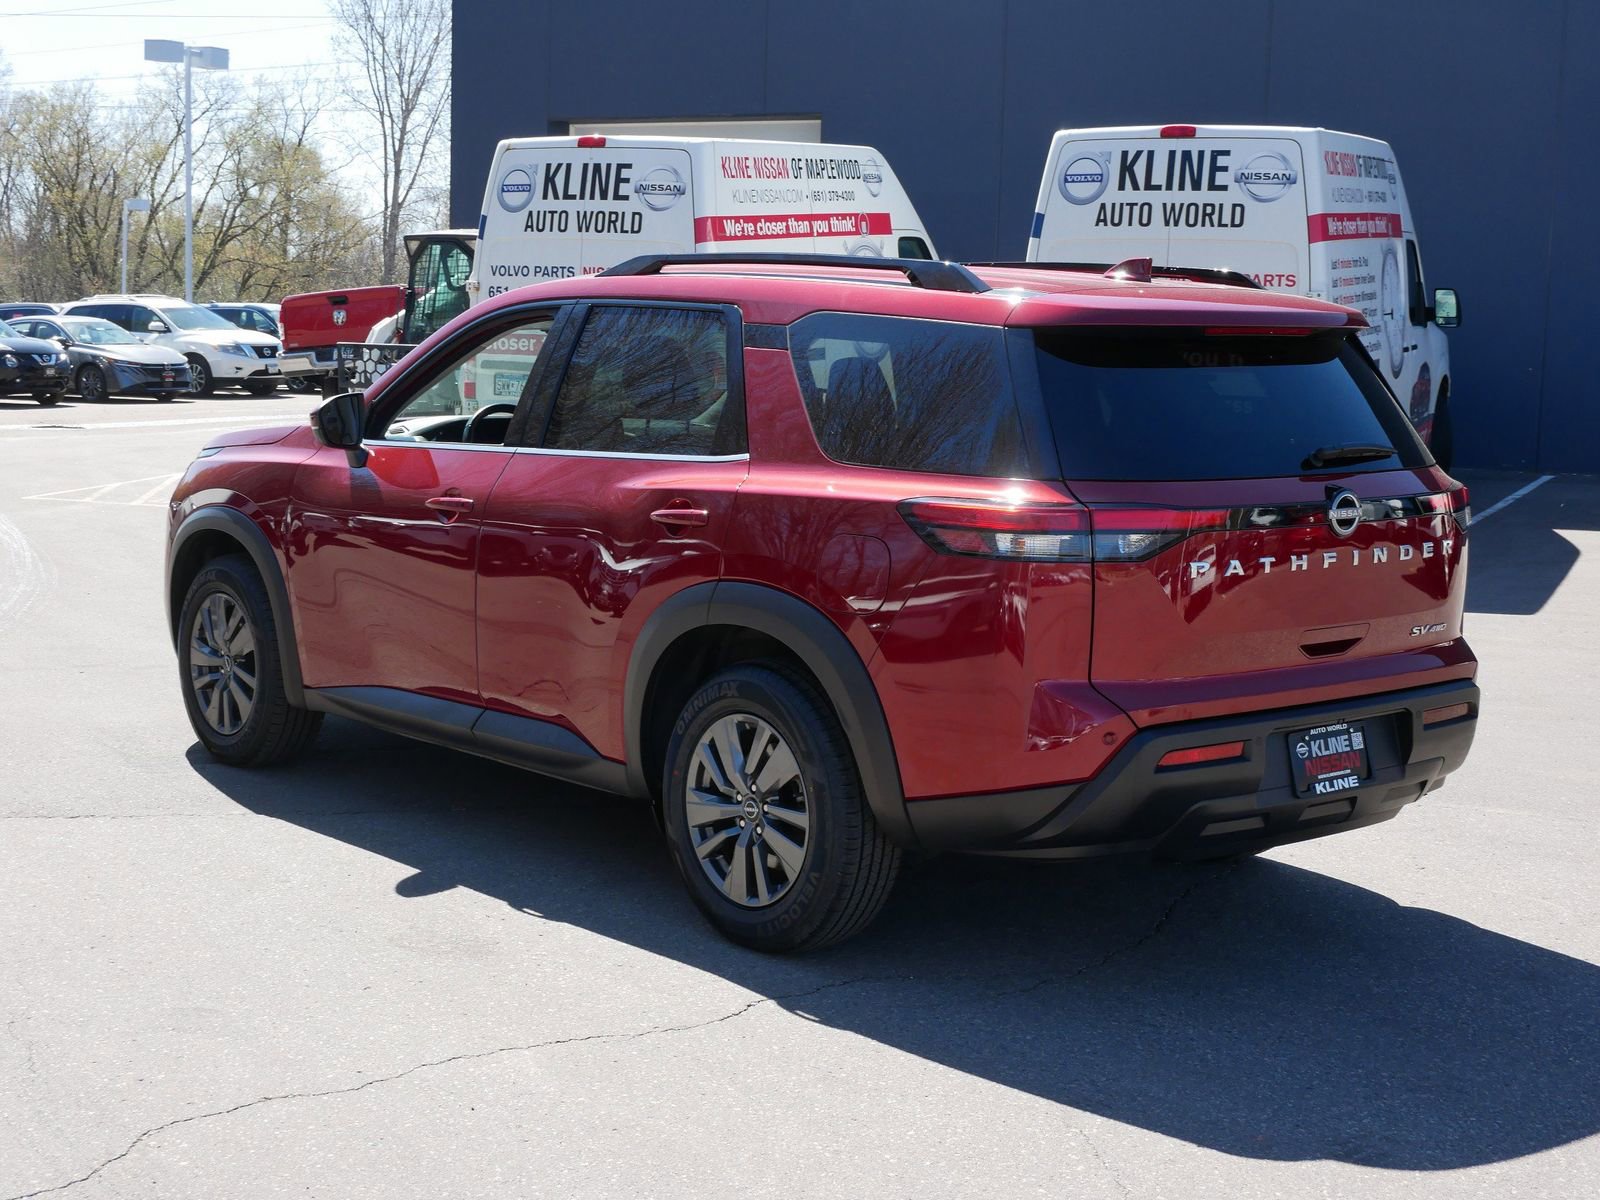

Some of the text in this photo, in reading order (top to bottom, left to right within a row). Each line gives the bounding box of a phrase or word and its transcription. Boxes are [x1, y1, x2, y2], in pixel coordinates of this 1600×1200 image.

[720, 156, 862, 180] KLINE NISSAN OF MAPLEWOOD
[1117, 149, 1231, 192] KLINE
[1239, 171, 1292, 181] NISSAN
[502, 184, 531, 192] VOLVO
[542, 162, 633, 202] KLINE
[638, 183, 682, 193] NISSAN
[811, 190, 827, 203] (651)
[524, 210, 643, 235] AUTO WORLD
[1094, 202, 1246, 229] AUTO WORLD
[723, 216, 856, 237] We're closer than you think!
[490, 265, 575, 278] VOLVO PARTS
[1330, 509, 1362, 518] NISSAN
[1188, 540, 1453, 579] PATHFINDER
[1410, 624, 1431, 637] SV
[676, 680, 740, 735] OMNIMAX
[1310, 723, 1348, 735] AUTO WORLD
[1310, 735, 1351, 758] KLINE
[1304, 751, 1361, 777] NISSAN
[1314, 776, 1359, 795] KLINE
